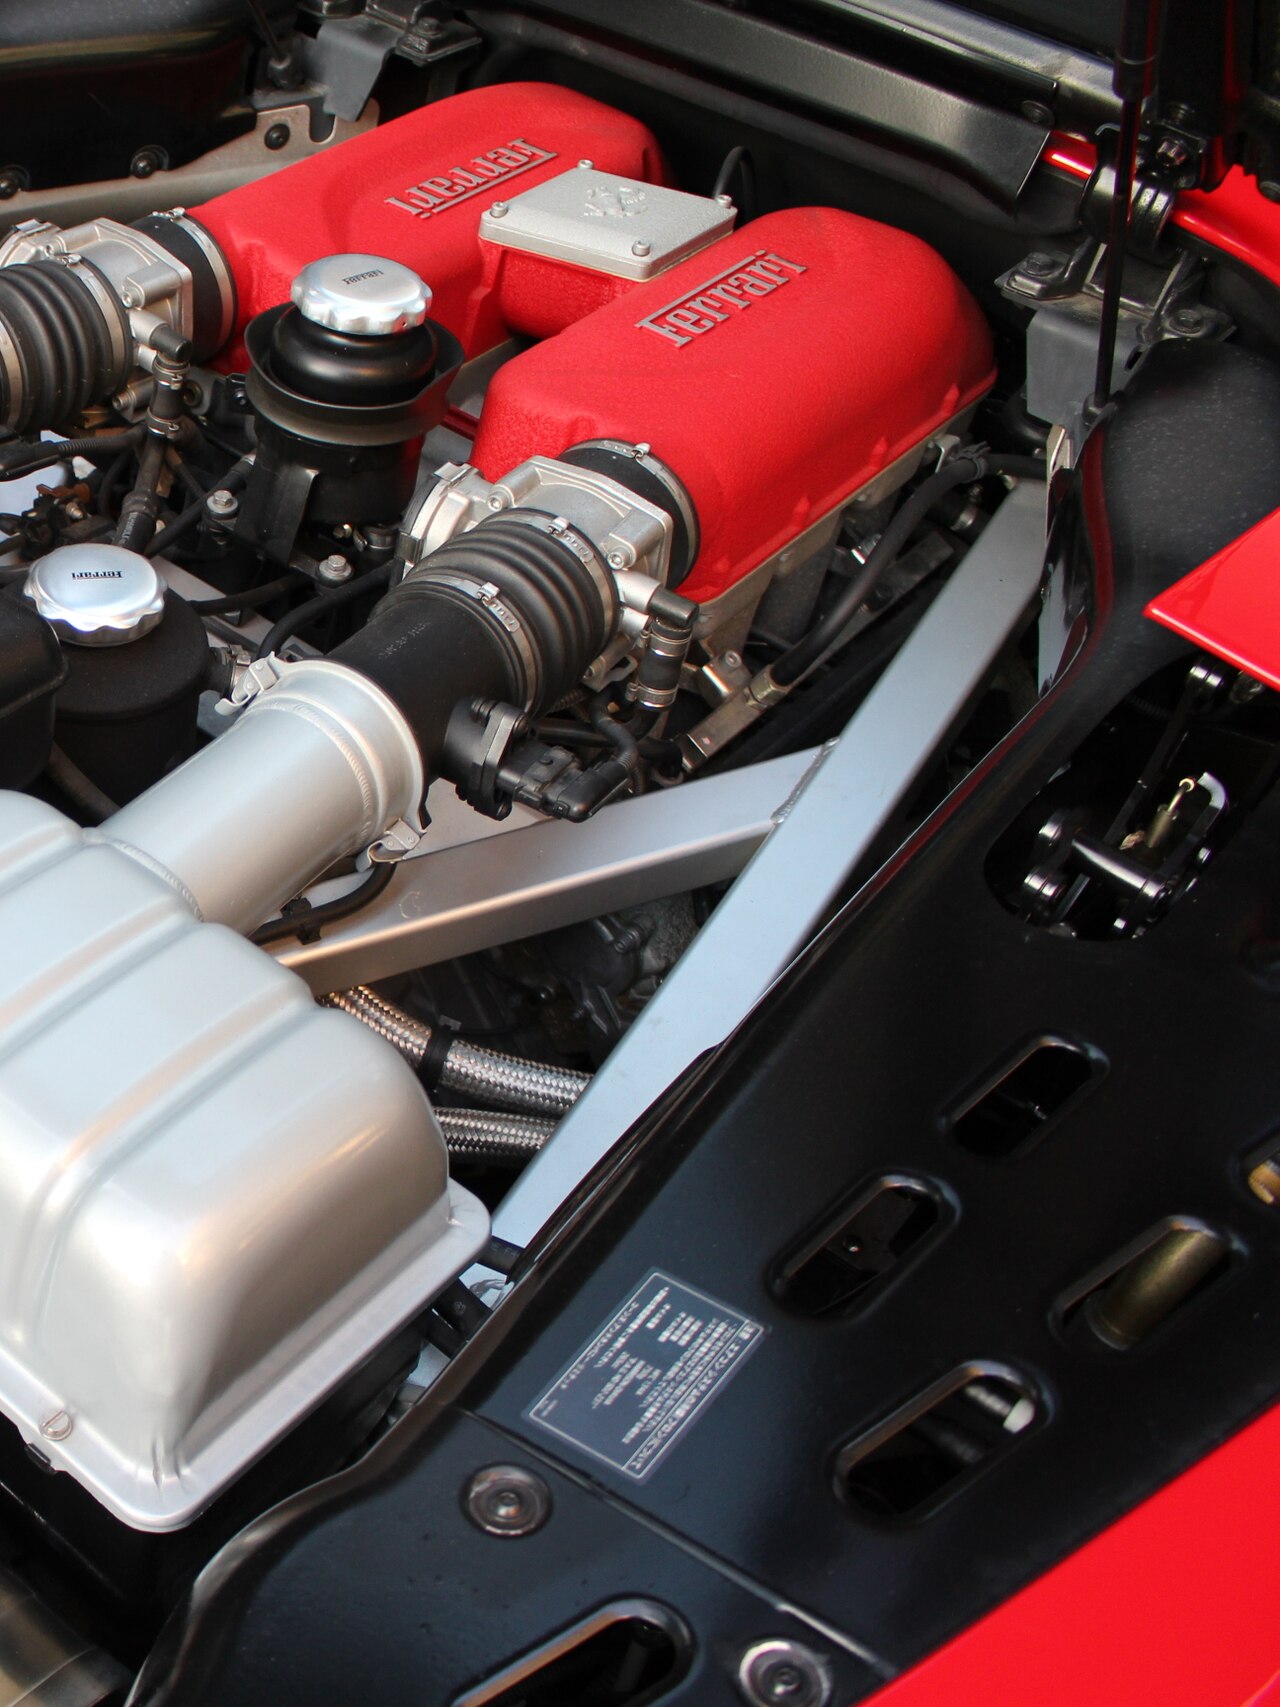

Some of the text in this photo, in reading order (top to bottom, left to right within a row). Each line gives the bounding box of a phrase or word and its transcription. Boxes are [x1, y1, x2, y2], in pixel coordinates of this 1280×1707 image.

[384, 138, 558, 219] Ferrari
[342, 269, 384, 285] Ferrari
[634, 249, 807, 347] Ferrari
[71, 571, 123, 580] Ferrari
